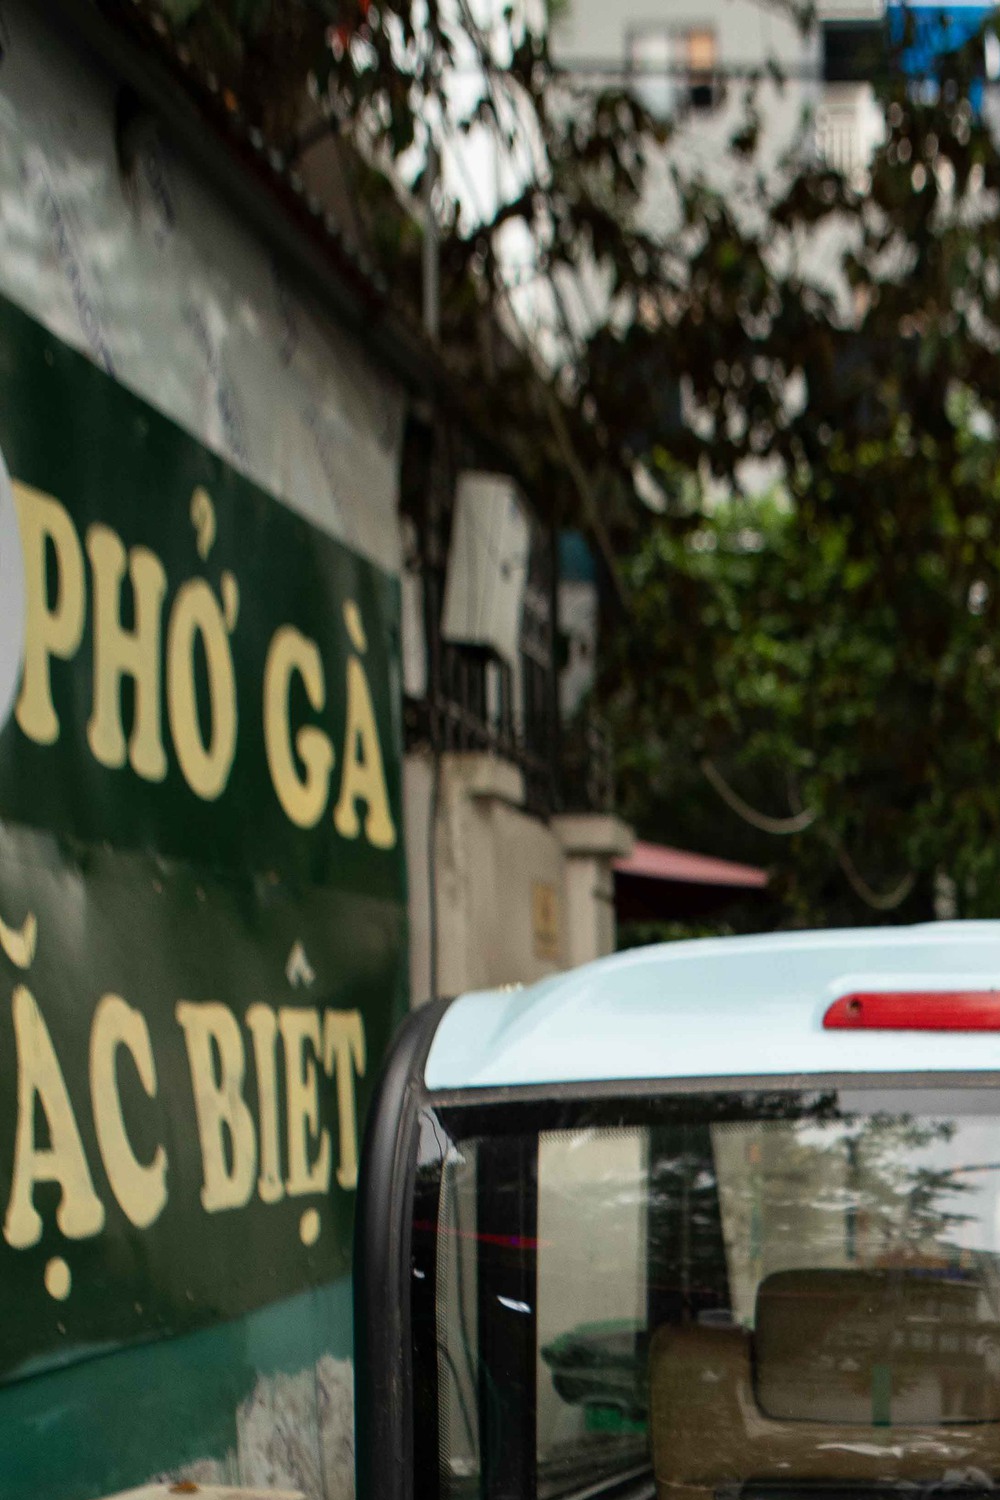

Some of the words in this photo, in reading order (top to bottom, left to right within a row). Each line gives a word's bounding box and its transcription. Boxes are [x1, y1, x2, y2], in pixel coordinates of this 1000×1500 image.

[12, 478, 240, 801] PHỞ
[263, 598, 397, 851] GÀ
[175, 940, 367, 1246] BIỆT
